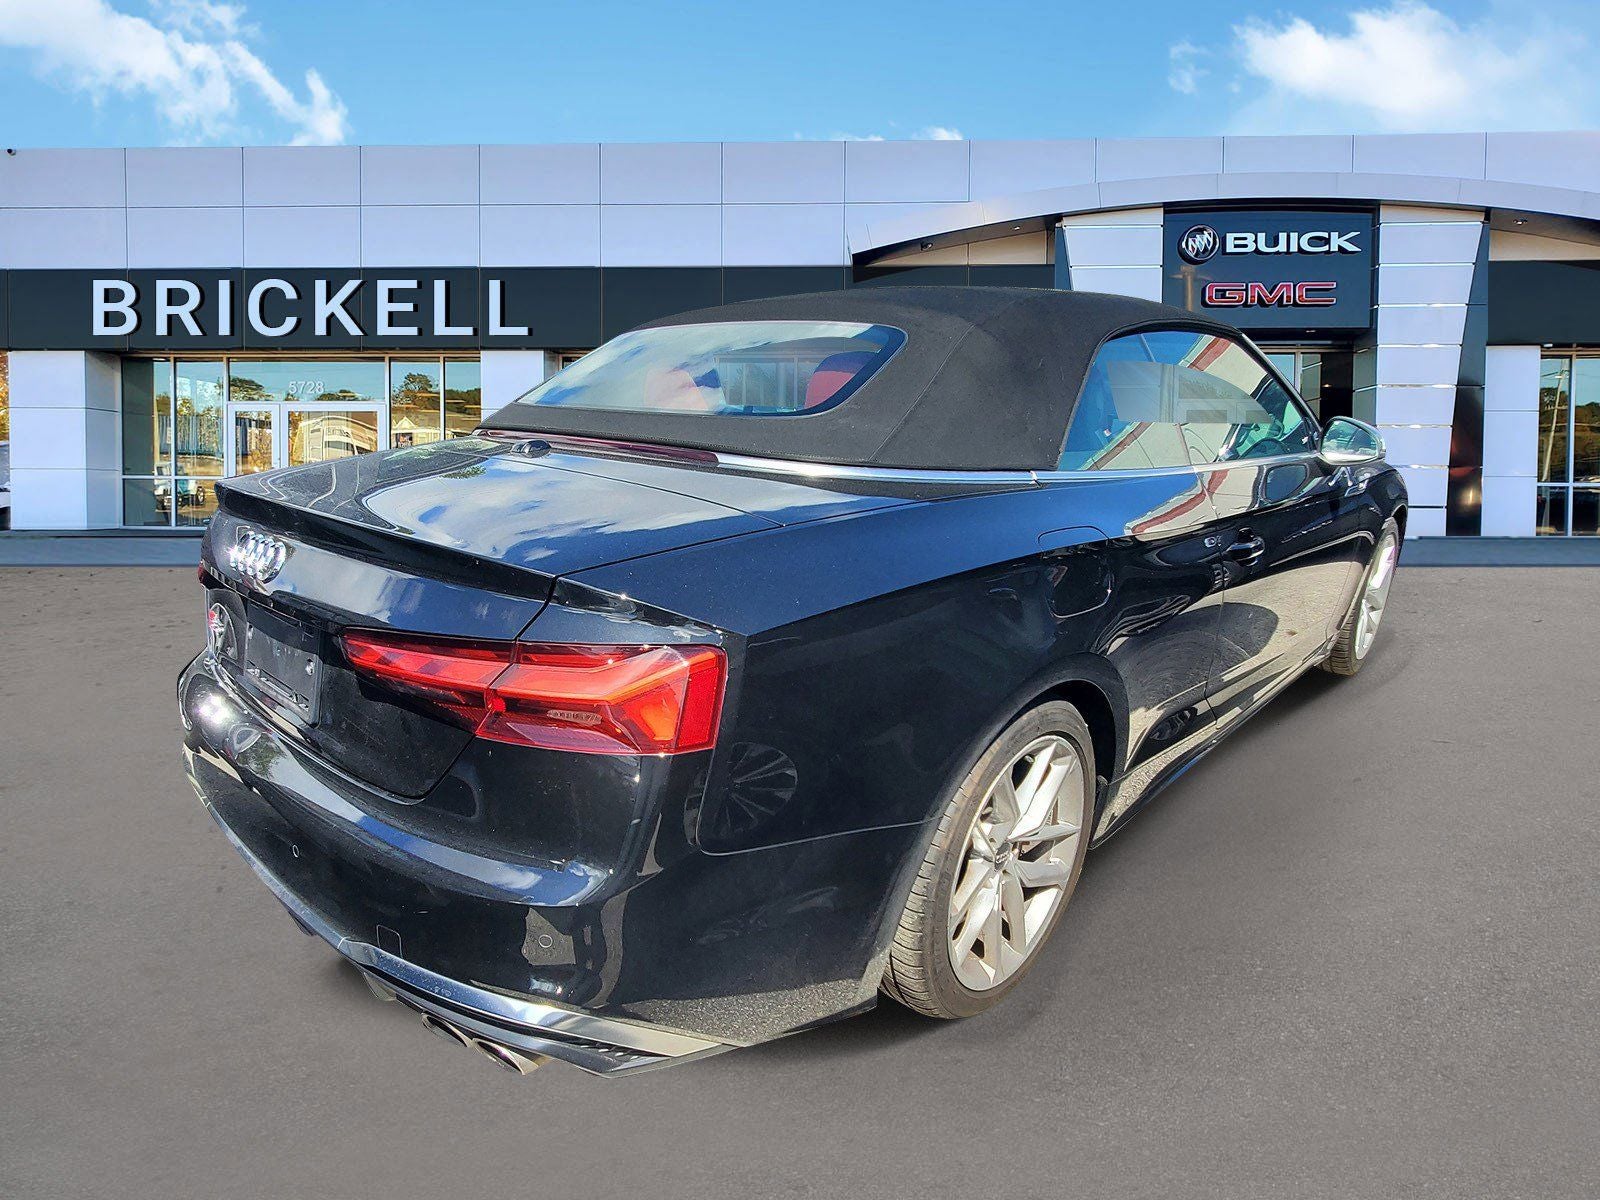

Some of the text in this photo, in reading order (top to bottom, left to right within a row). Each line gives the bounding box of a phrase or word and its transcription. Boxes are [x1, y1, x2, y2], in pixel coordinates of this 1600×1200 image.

[1225, 231, 1361, 253] BUICK
[1206, 282, 1337, 305] GMC
[92, 278, 530, 337] BRICKELL
[289, 380, 325, 394] 5728
